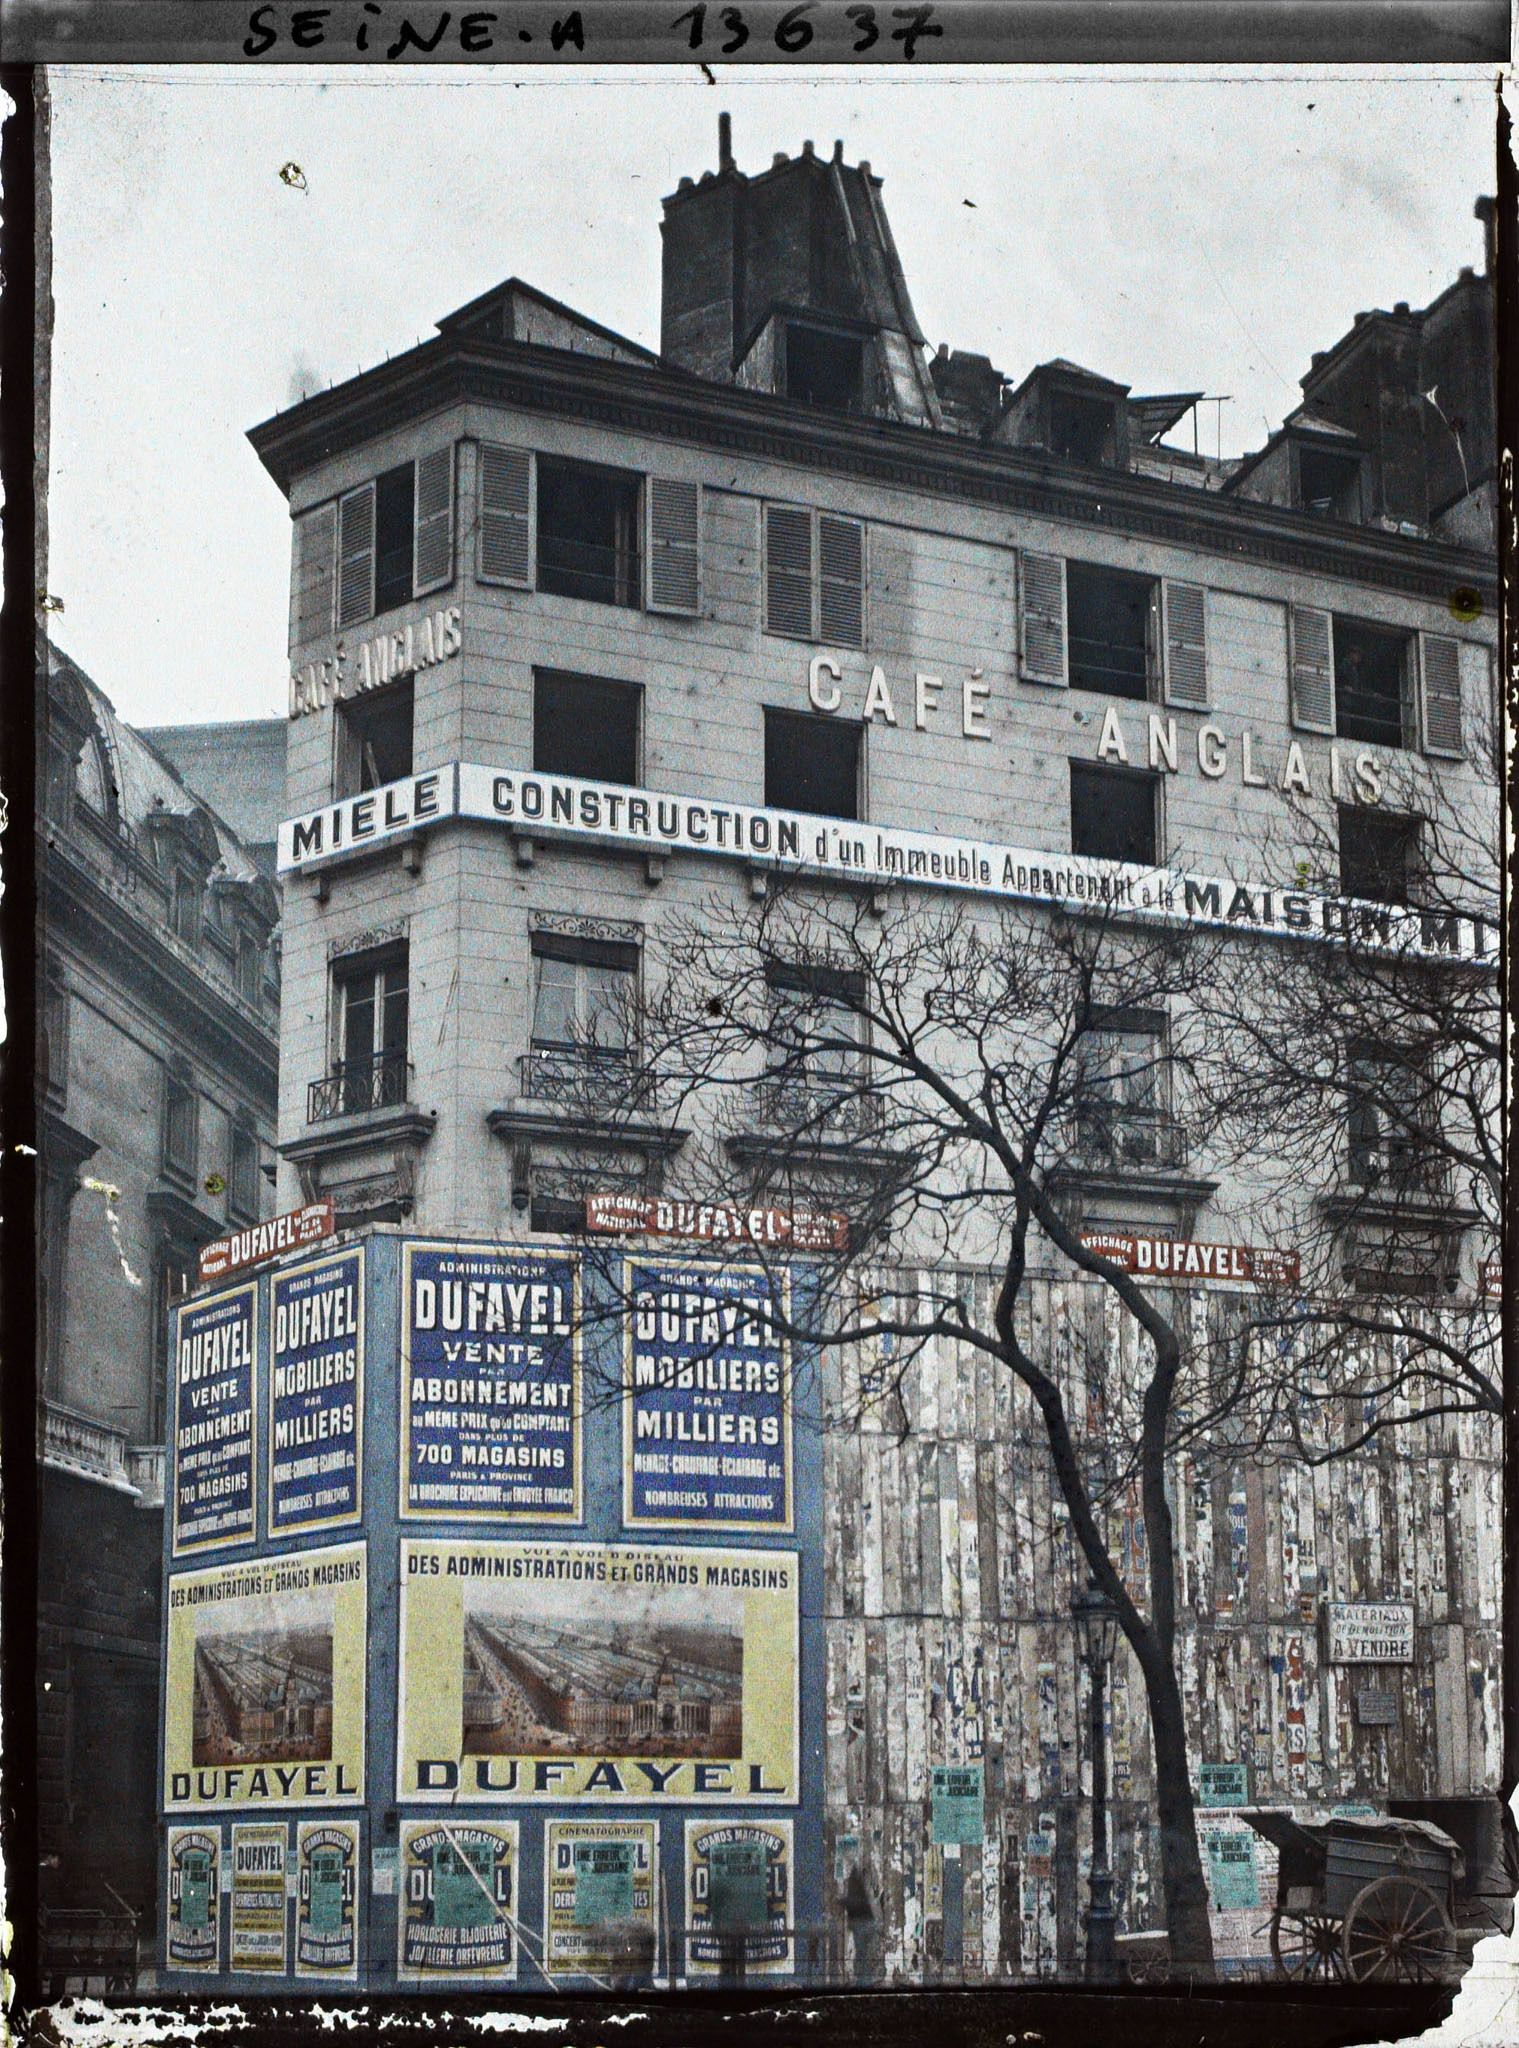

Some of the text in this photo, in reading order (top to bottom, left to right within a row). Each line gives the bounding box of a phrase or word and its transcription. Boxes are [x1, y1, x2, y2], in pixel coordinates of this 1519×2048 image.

[809, 655, 1382, 805] CAFÉ ANGLAIS
[292, 775, 440, 861] MIELE
[492, 776, 801, 858] CONSTRUCTION
[877, 834, 992, 885] Immeuble
[1002, 853, 1136, 907] Appartenant
[1184, 879, 1390, 944] MAISON
[657, 1201, 781, 1241] DUFAYEL
[231, 1215, 295, 1265] DUFAYEL
[1081, 1235, 1133, 1254] AFFICHAGE
[1137, 1239, 1245, 1277] DUFAYEL
[276, 1285, 357, 1354] DUFAYEL
[416, 1279, 570, 1335] DUFAYEL
[637, 1291, 781, 1348] DUFAYEL
[181, 1318, 251, 1384] DUFAYEL
[442, 1341, 544, 1365] VENTE
[275, 1348, 356, 1399] MOBILIERS
[636, 1355, 780, 1393] MOBILIERS
[191, 1379, 238, 1408] VENTE
[412, 1378, 572, 1407] ABONNEMENT
[693, 1396, 722, 1407] PAR
[179, 1409, 251, 1450] ABONNEMENT
[275, 1403, 354, 1450] MILLIERS
[461, 1412, 488, 1429] PRIX
[514, 1413, 570, 1432] COMPTANT
[637, 1410, 779, 1445] MILLIERS
[417, 1444, 565, 1468] 700 MAGASINS
[180, 1485, 196, 1505] 700
[198, 1471, 248, 1500] MAGASINS
[451, 1471, 477, 1480] PARIS
[714, 1493, 773, 1510] ATTRACTIONS
[171, 1560, 361, 1608] DES ADMINISTRATIONS ET GRANDS MAGASINS
[408, 1555, 788, 1590] DES ADMINISTRATIONS ET GRANDS MAGASINS
[1333, 1638, 1410, 1657] A VENDRE
[172, 1765, 358, 1801] DUFAYEL
[416, 1759, 787, 1794] DUFAYEL
[413, 1829, 505, 1853] GRANDS MAGASINS
[696, 1828, 781, 1852] GRANDS MAGASINS
[237, 1845, 282, 1871] DUFAYEL
